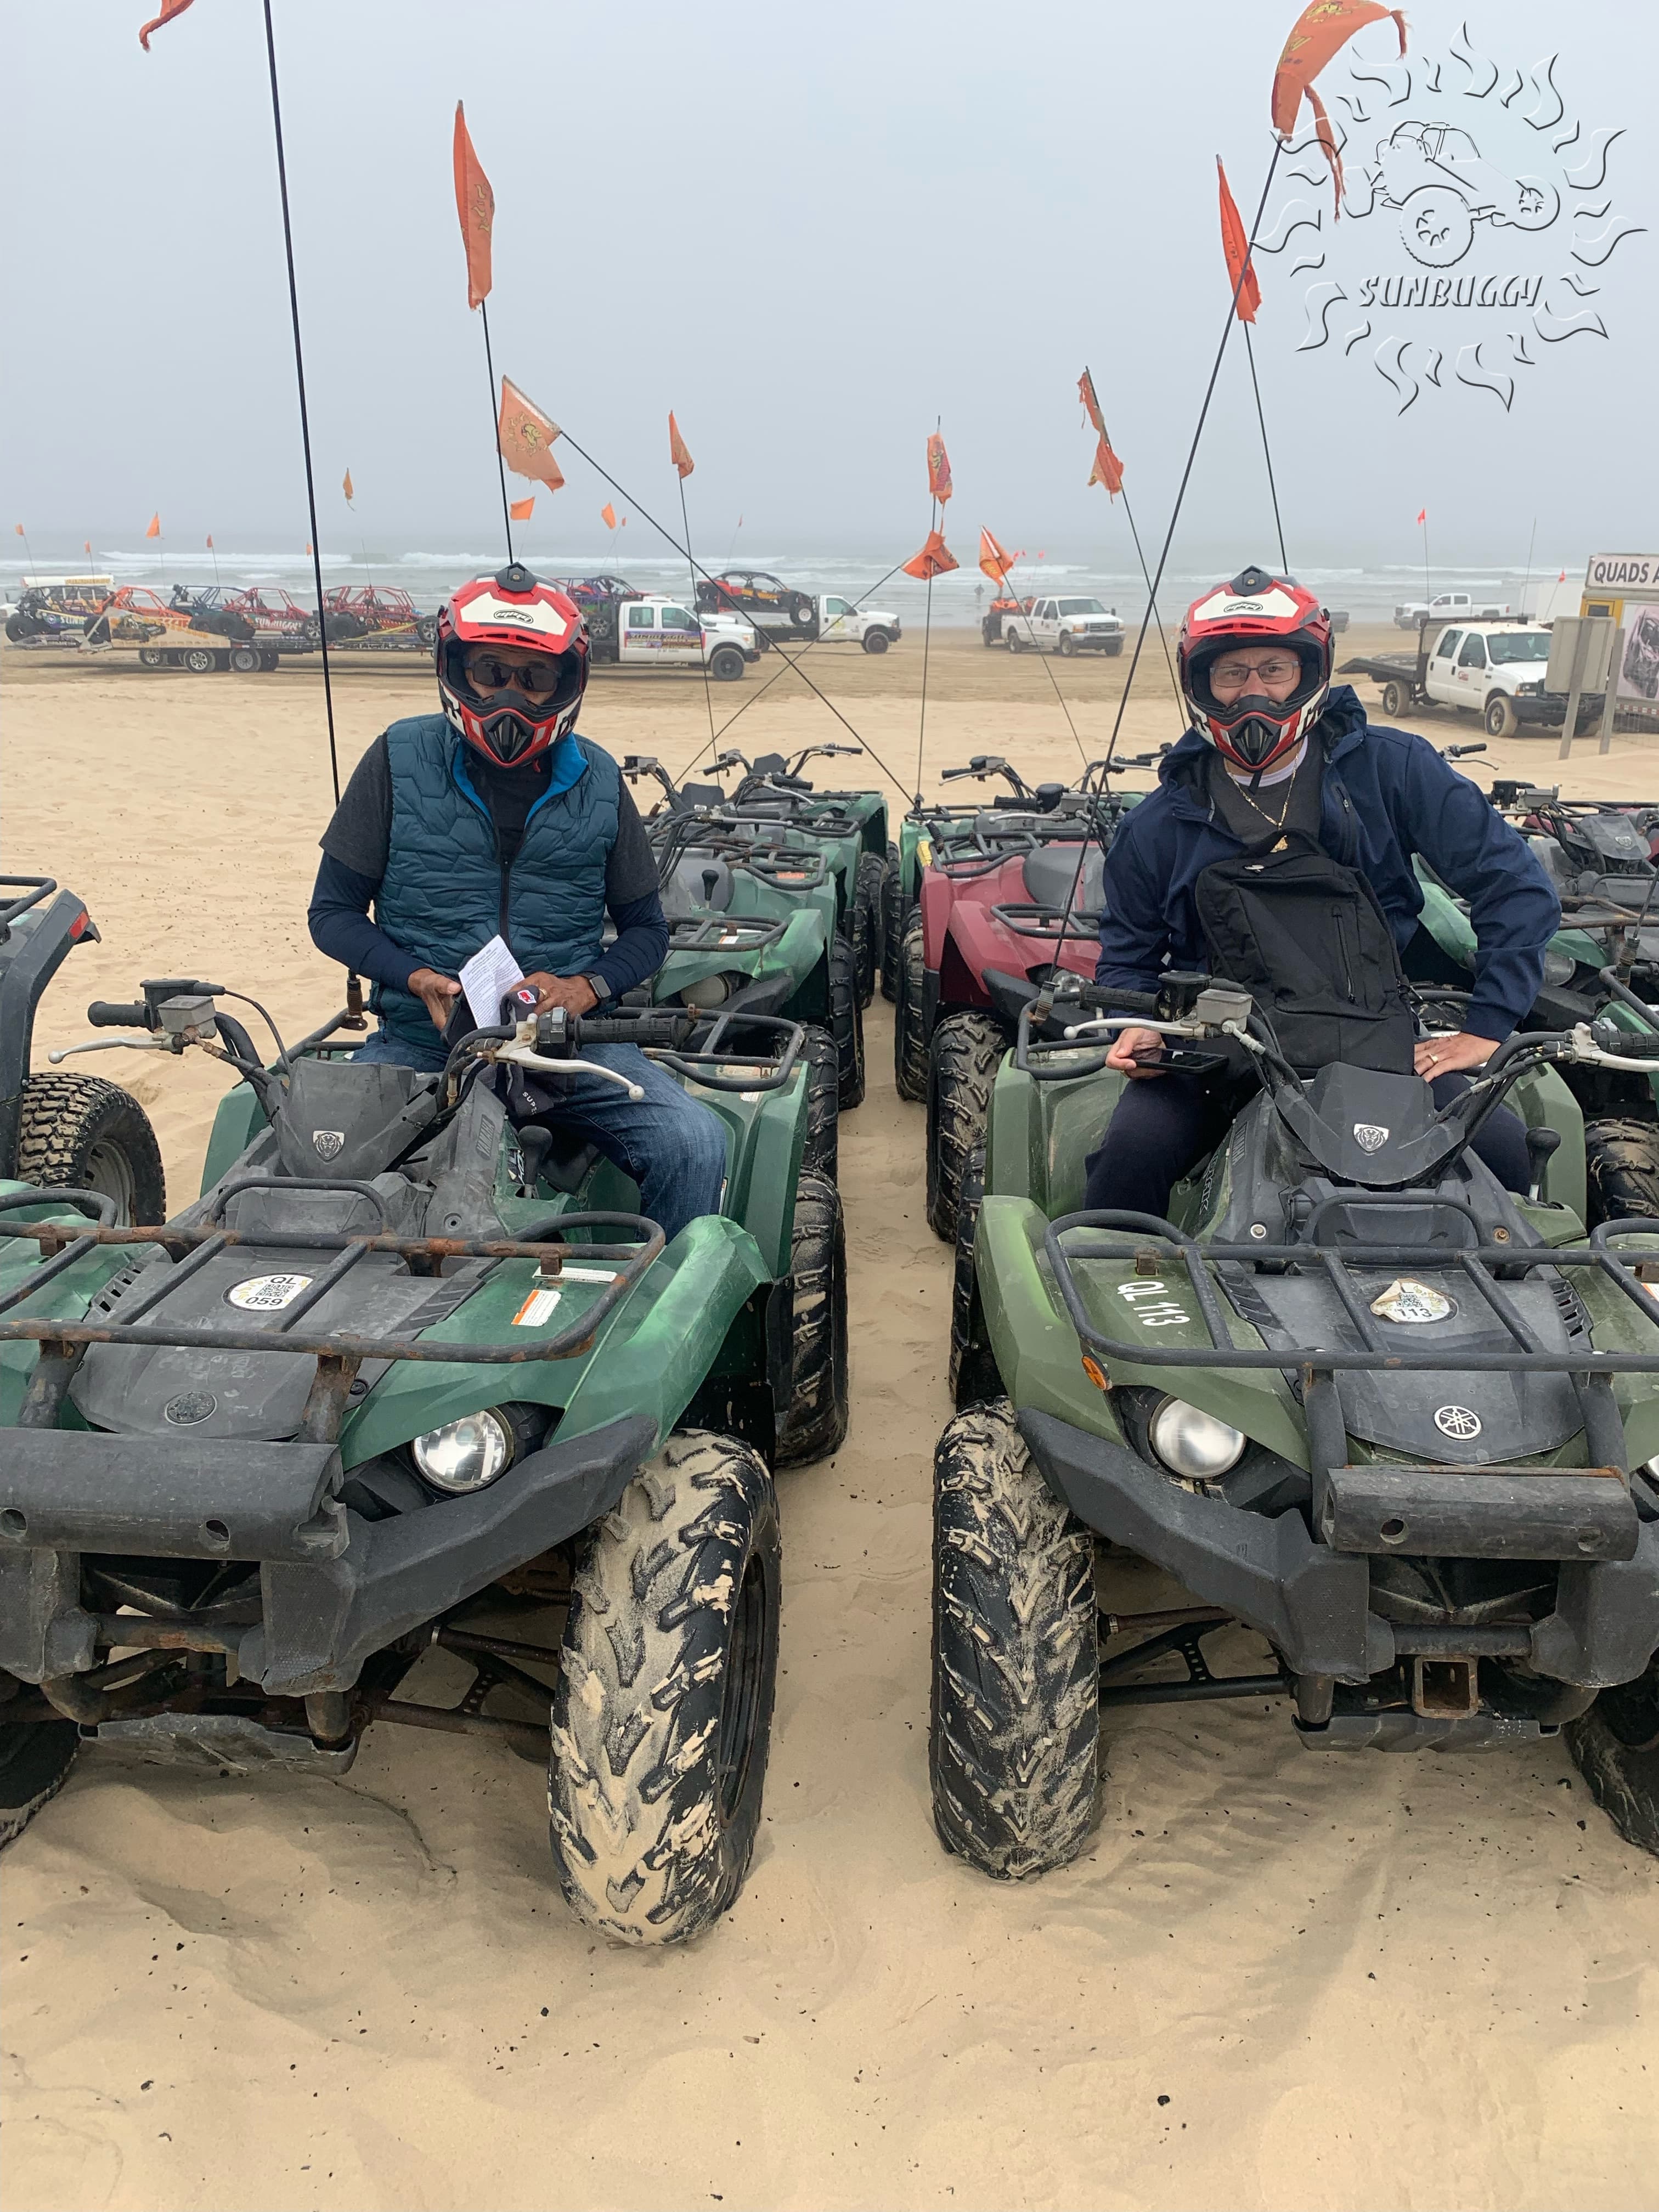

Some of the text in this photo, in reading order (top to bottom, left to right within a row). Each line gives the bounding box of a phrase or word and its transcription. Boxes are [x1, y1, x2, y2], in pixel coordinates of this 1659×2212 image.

[1594, 561, 1650, 584] QUADS
[476, 1117, 495, 1157] YAMAHA
[270, 1277, 297, 1285] QL
[245, 1296, 283, 1306] 059
[1118, 1281, 1190, 1326] QL 113
[1394, 1308, 1432, 1317] 113
